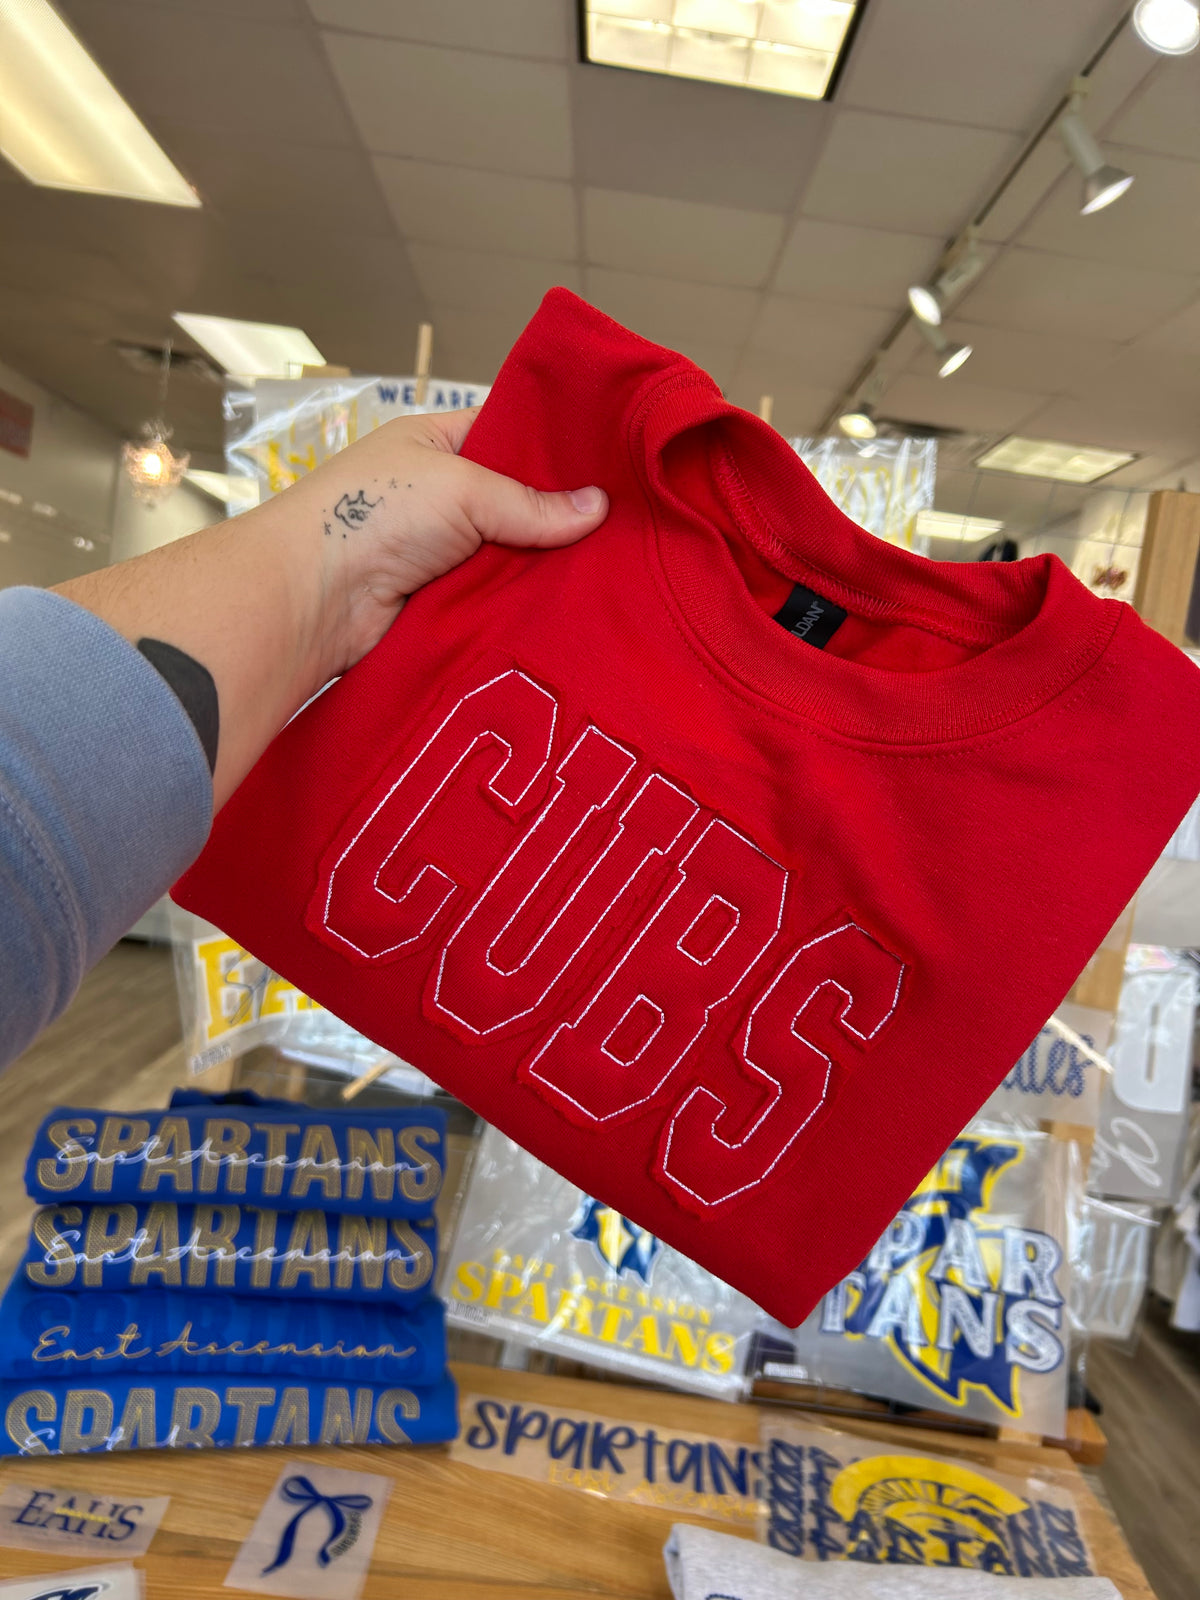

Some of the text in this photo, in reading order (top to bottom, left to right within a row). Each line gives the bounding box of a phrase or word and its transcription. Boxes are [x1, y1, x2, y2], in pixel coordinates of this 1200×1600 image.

[790, 603, 825, 638] LDAN
[324, 669, 906, 1206] CUBS
[36, 1116, 447, 1202] SPARTANS
[26, 1202, 434, 1291] SPARTANS
[867, 1209, 1066, 1306] PAR
[32, 1321, 417, 1362] East Ascension
[452, 1260, 736, 1376] SPARTANS
[5, 1387, 421, 1456] SPARTANS
